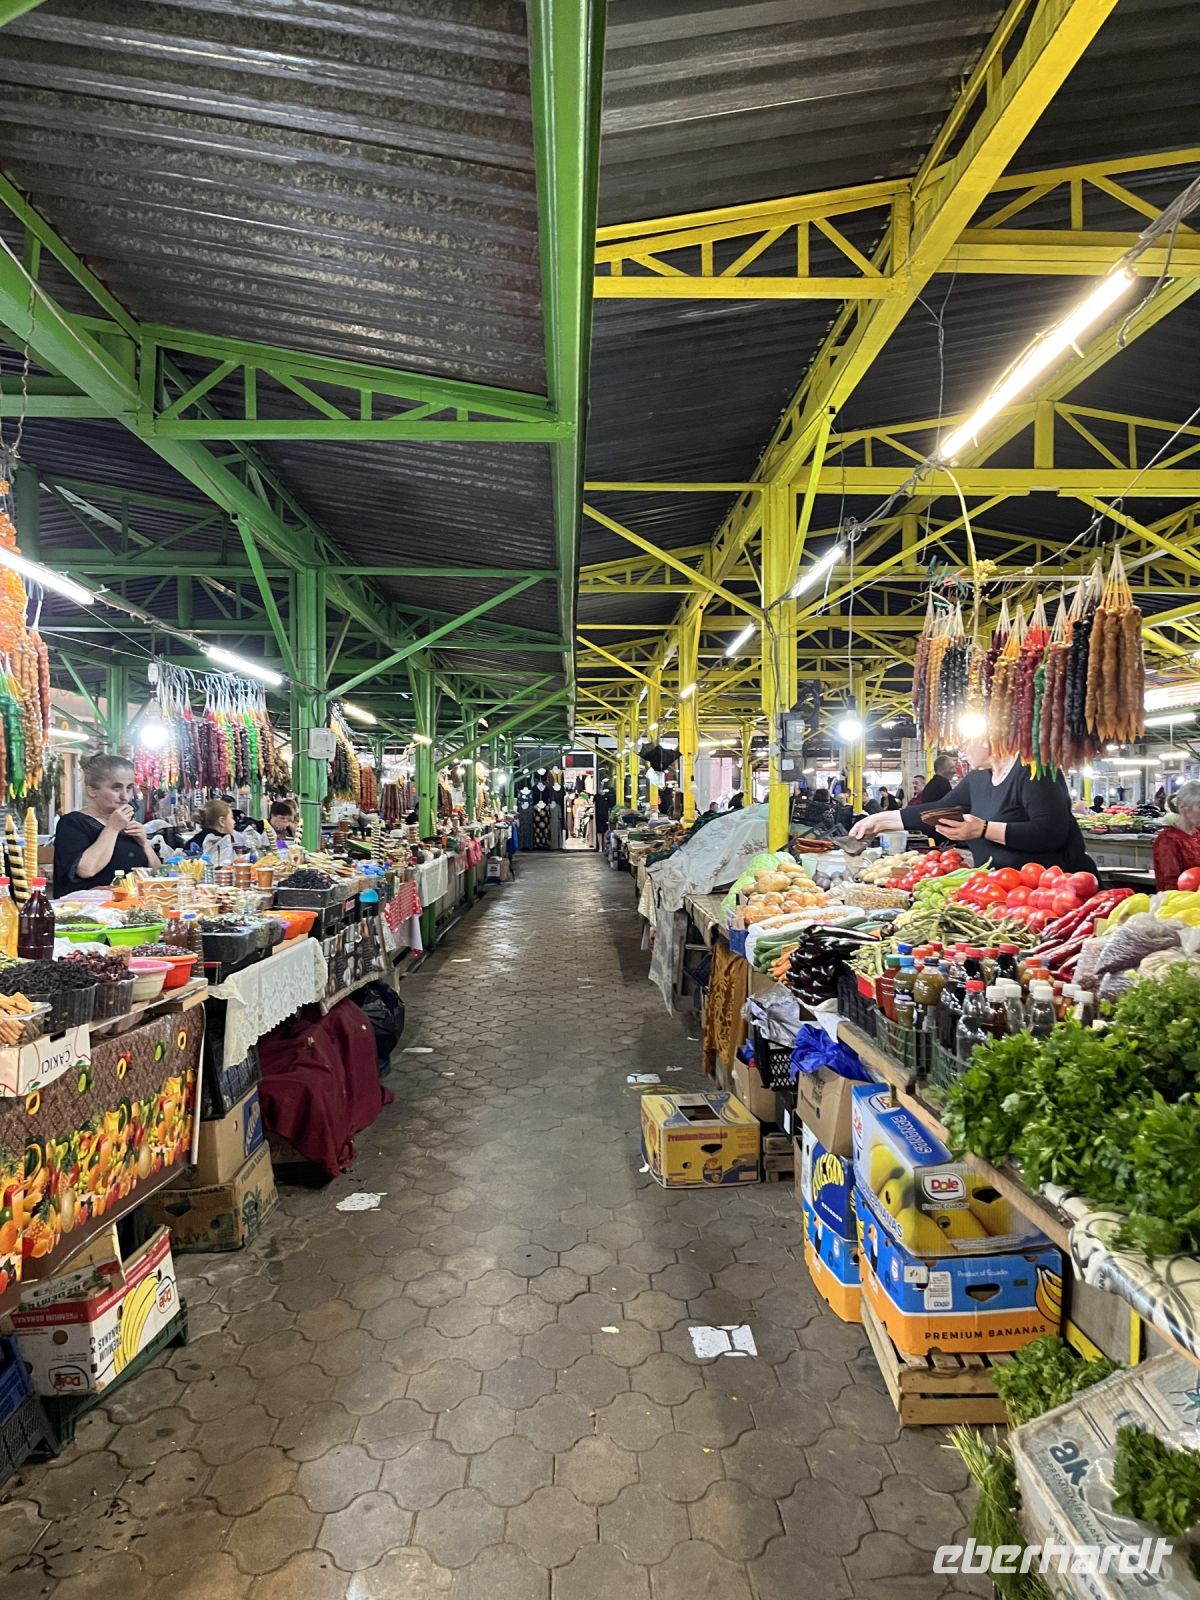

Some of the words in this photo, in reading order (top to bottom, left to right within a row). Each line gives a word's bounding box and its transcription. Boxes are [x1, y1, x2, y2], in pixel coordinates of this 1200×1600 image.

[890, 1114, 933, 1154] BANANAS
[930, 1177, 959, 1191] Dole
[158, 1288, 173, 1309] Dole
[924, 1331, 983, 1340] PREMIUM
[988, 1325, 1046, 1337] BANANAS
